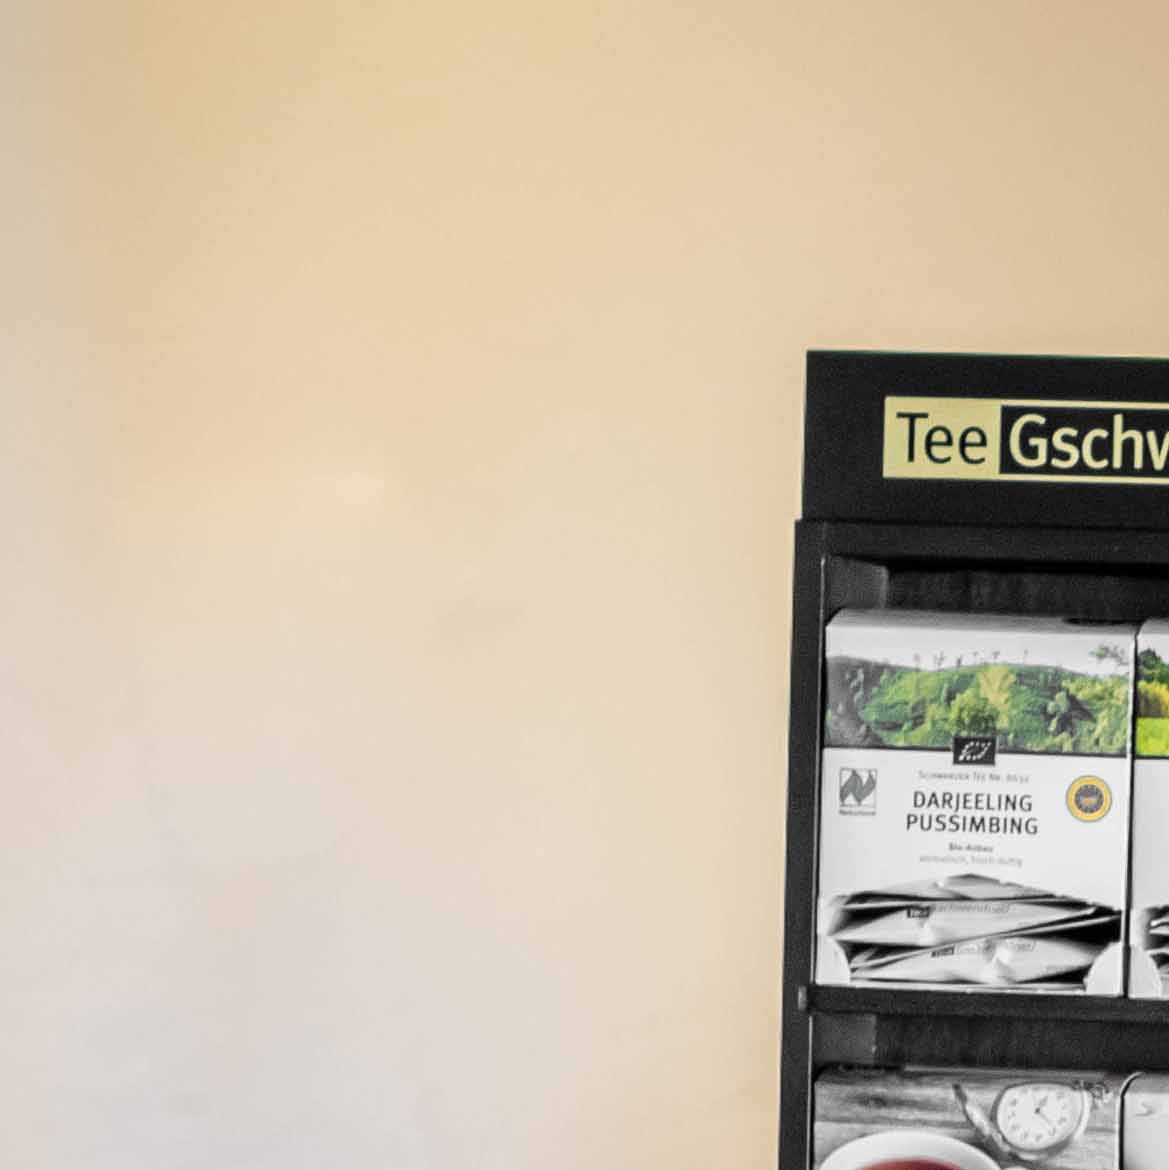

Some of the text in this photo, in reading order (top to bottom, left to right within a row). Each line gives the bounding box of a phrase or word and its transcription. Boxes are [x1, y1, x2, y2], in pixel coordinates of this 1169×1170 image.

[896, 411, 988, 464] Tee
[912, 791, 1033, 813] DARJEELING
[905, 813, 1039, 836] PUSSIMBING
